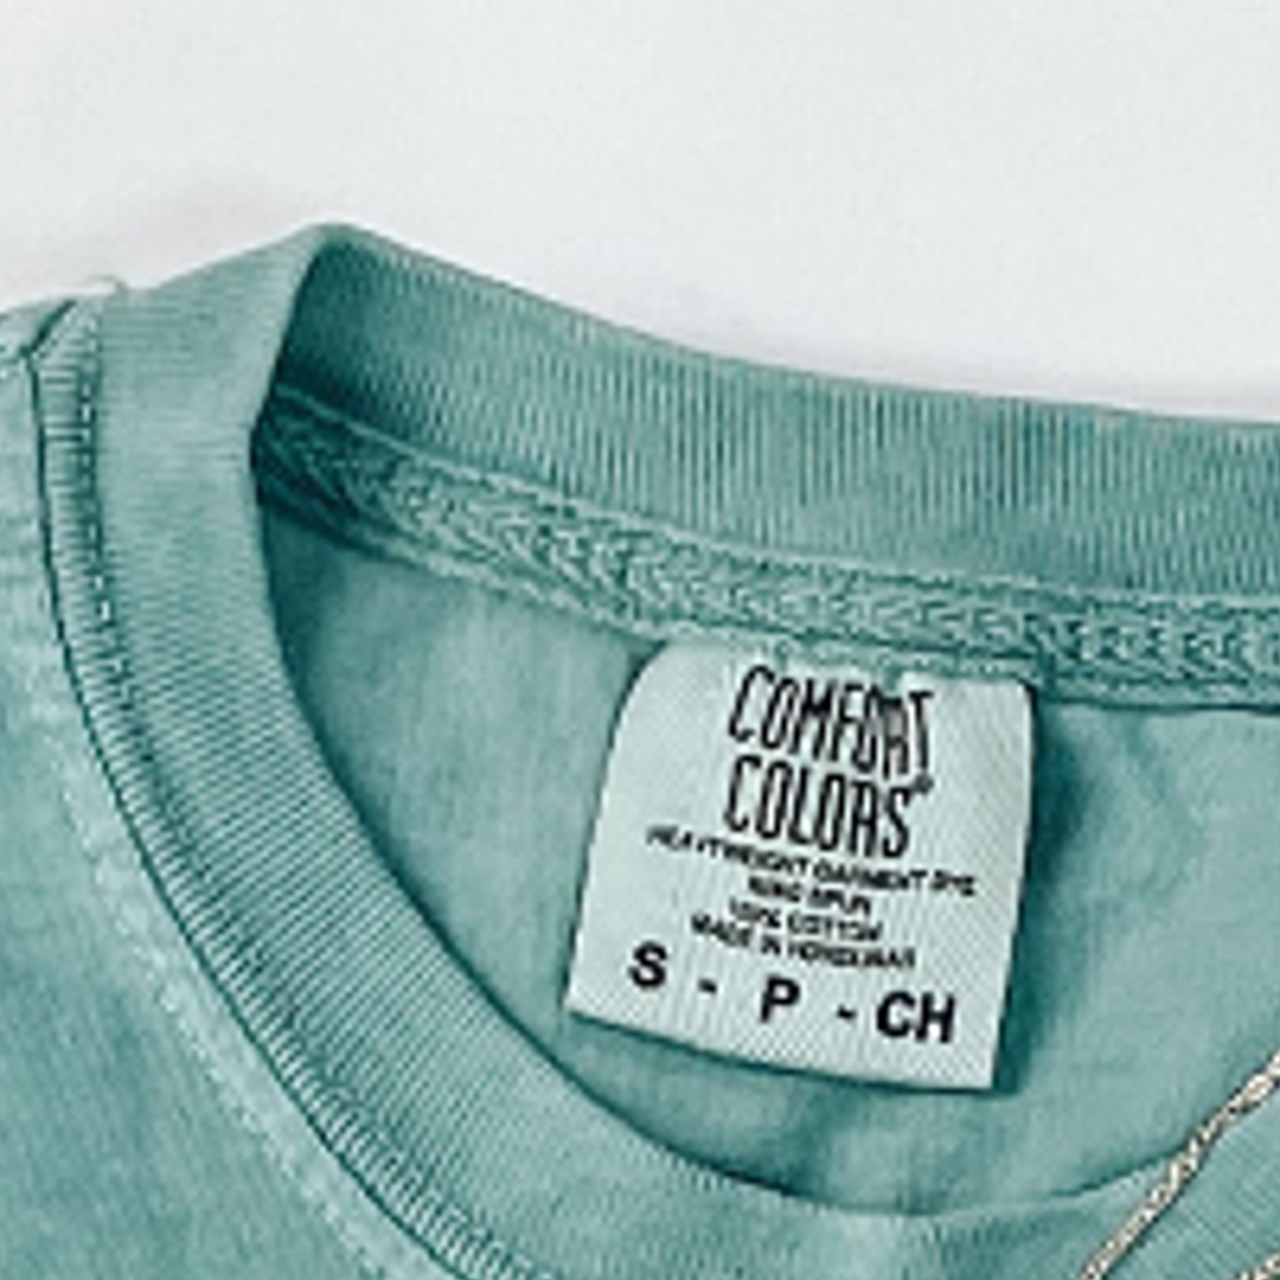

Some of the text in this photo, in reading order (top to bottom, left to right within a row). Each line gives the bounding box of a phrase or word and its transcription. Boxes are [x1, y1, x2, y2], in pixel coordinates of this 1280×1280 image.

[728, 664, 934, 780] COMFORT
[724, 754, 910, 859] COLORS
[628, 941, 668, 989] S
[759, 976, 801, 1023] P
[875, 990, 956, 1044] CH
